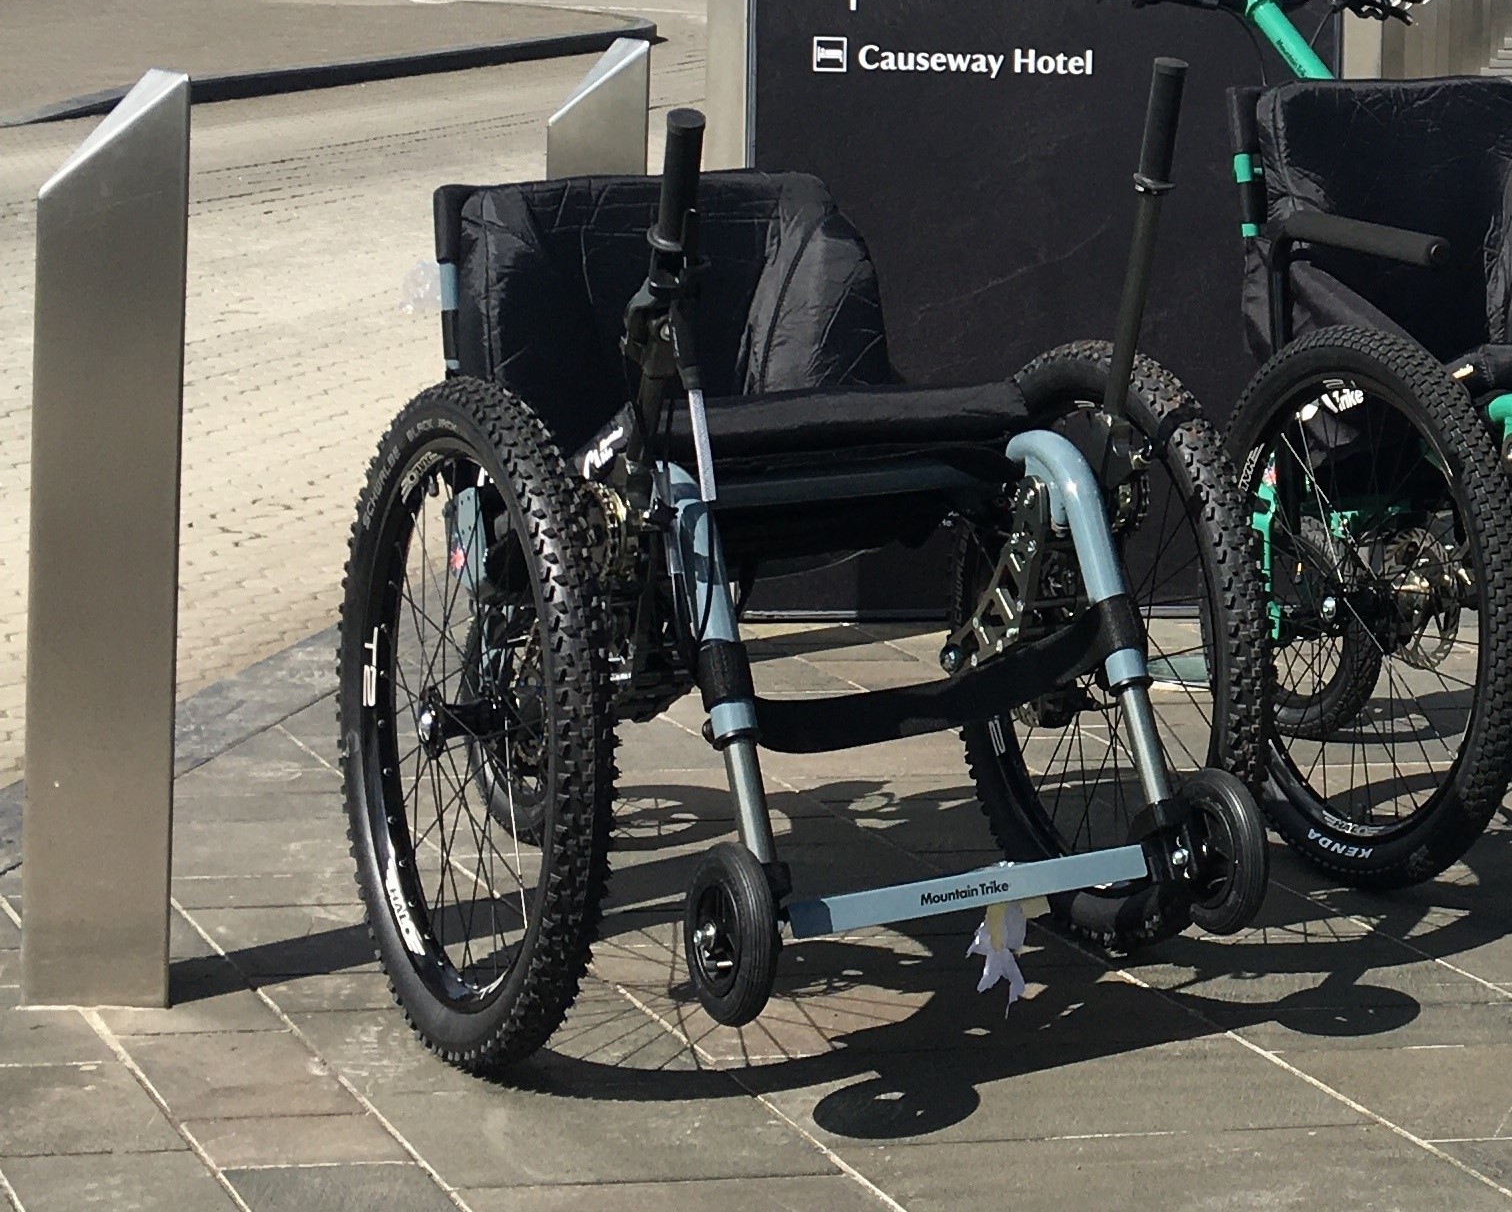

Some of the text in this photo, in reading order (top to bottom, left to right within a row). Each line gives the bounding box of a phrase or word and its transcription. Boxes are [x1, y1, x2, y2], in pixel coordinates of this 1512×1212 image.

[858, 44, 1092, 78] Causeway Hotel
[1307, 828, 1373, 859] KENDA
[920, 879, 1009, 906] Mountain Trike
